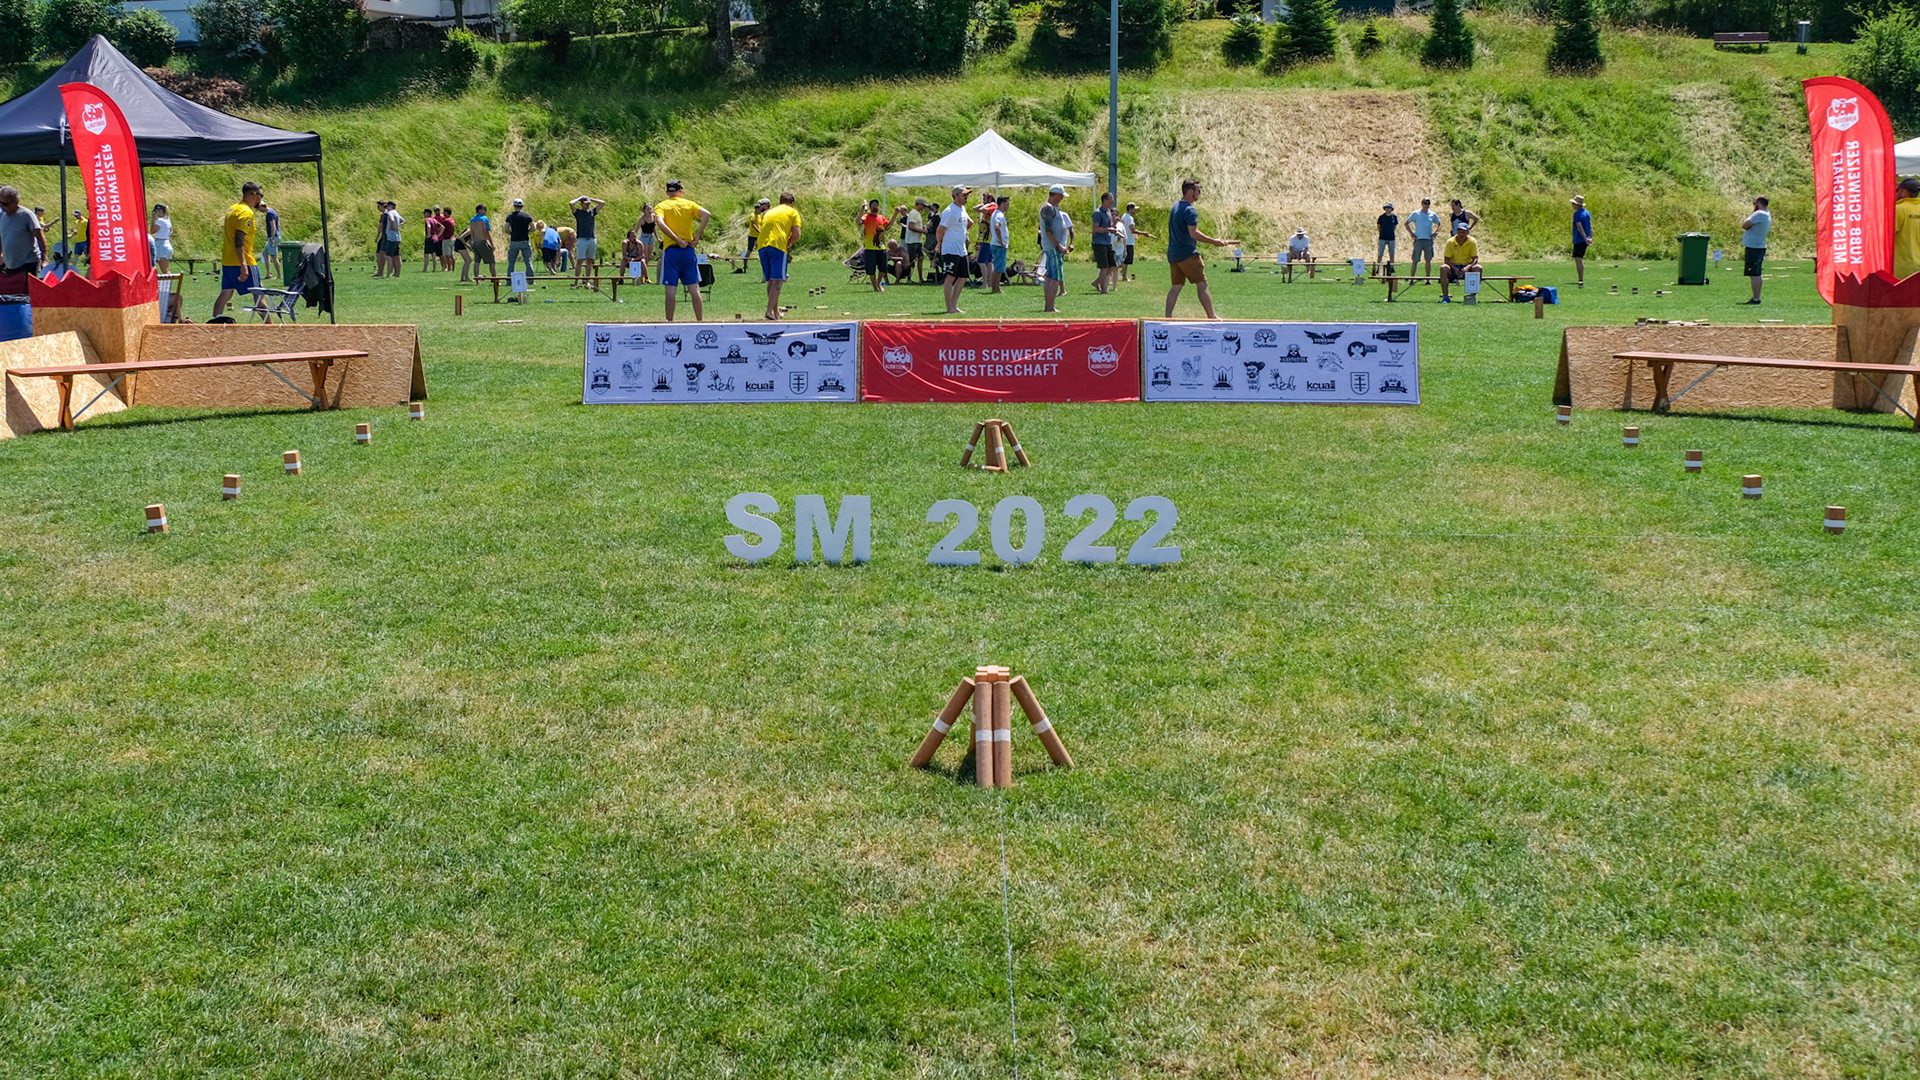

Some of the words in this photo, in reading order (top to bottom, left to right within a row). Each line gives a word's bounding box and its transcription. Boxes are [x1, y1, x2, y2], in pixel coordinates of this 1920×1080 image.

[938, 348, 976, 361] KUBB
[981, 347, 1064, 361] SCHWEIZER
[942, 363, 1059, 377] MEISTERSCHAFT
[723, 492, 871, 562] SM
[925, 494, 1182, 566] 2022
